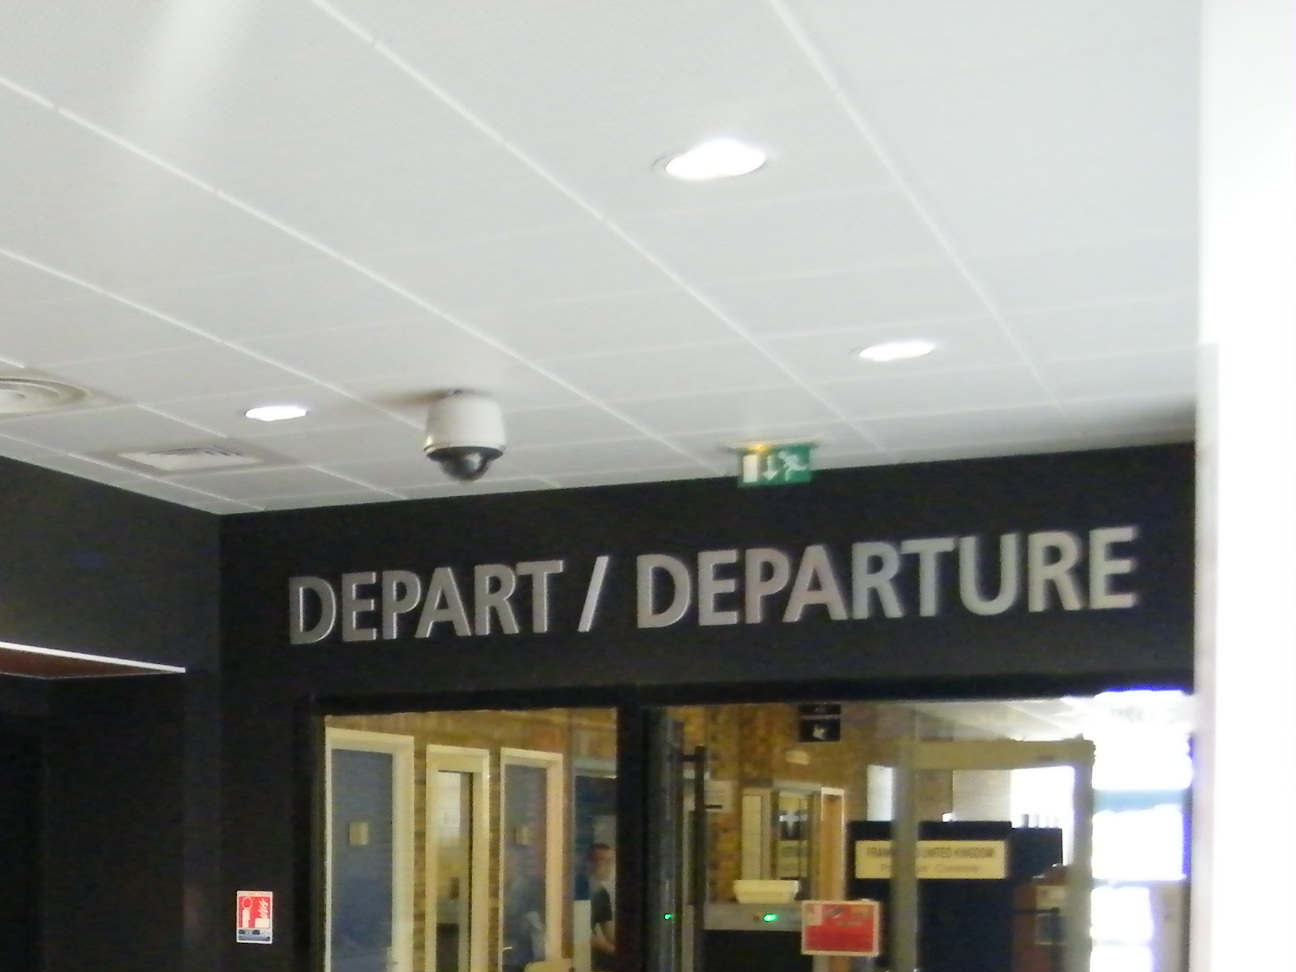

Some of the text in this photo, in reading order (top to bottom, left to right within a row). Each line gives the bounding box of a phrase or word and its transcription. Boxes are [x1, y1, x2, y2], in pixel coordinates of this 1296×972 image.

[289, 525, 1139, 645] DEPART / DEPARTURE
